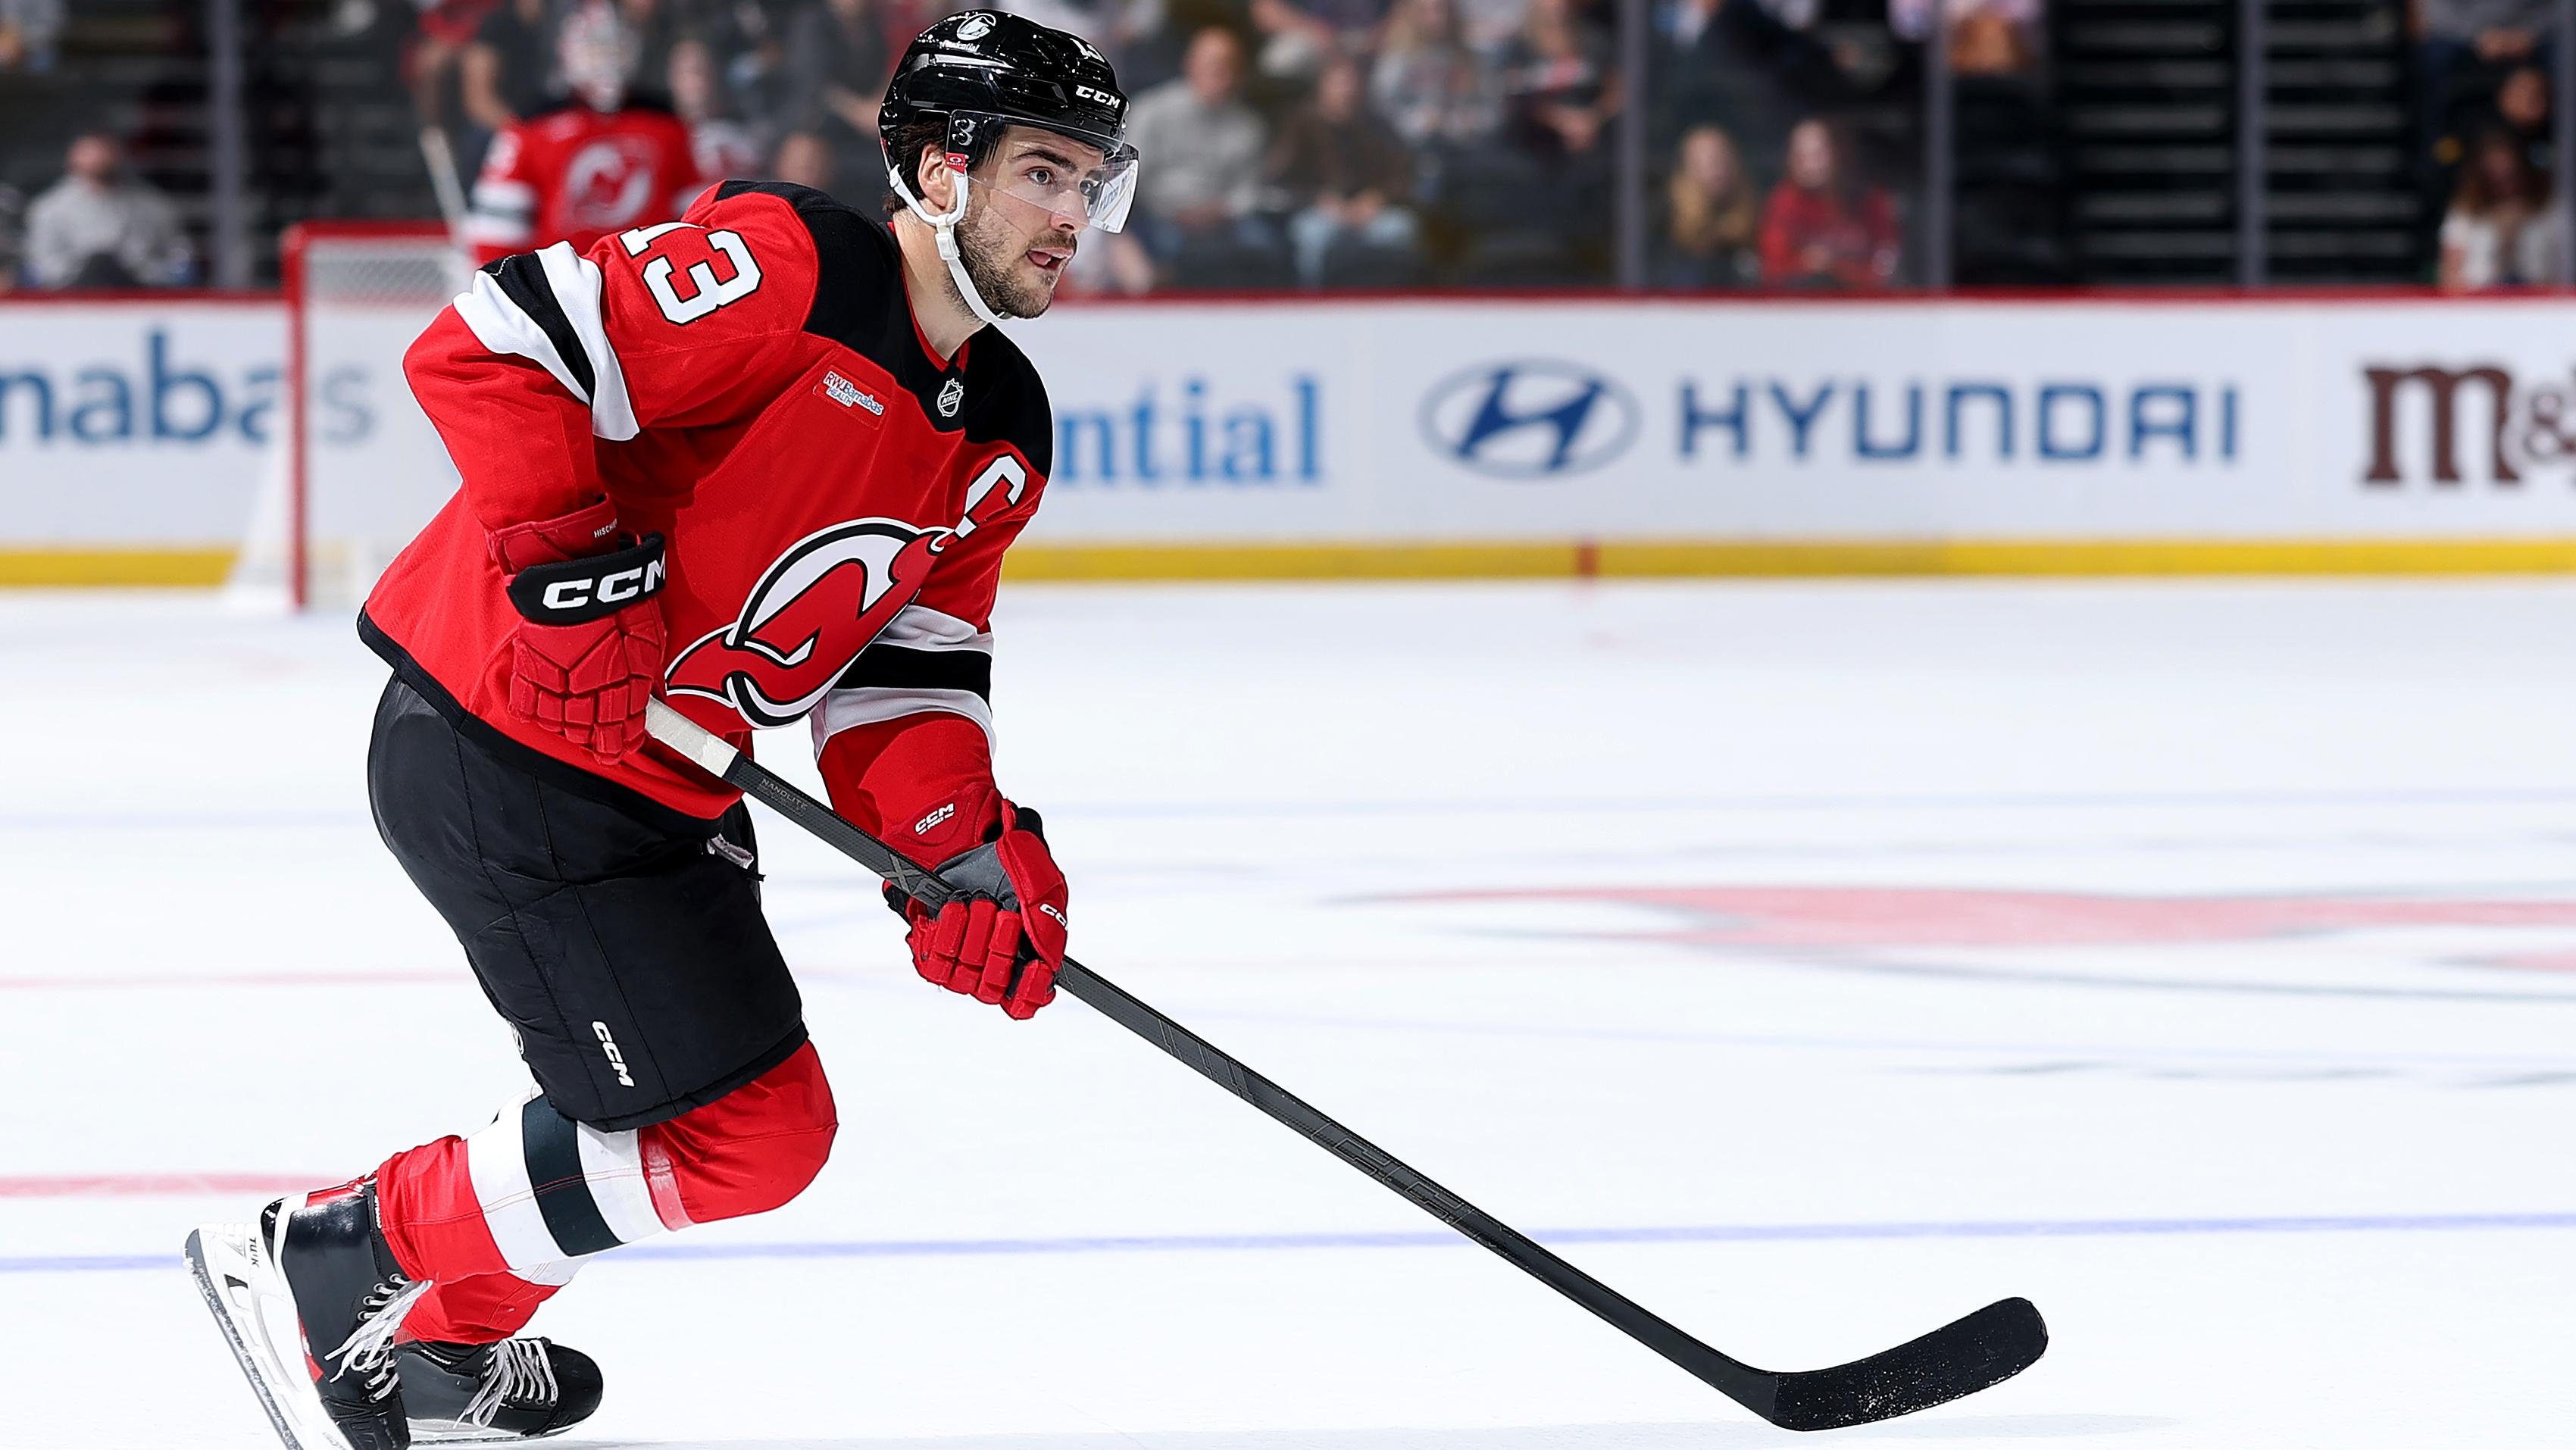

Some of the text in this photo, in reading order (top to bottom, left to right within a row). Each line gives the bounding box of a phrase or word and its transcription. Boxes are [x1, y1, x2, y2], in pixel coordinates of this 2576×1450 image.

[1075, 85, 1121, 108] CCM
[1055, 373, 1321, 485] ntial
[1678, 377, 2239, 464] HYUNDAI
[542, 549, 665, 609] CCM
[915, 803, 954, 833] CCM
[1039, 903, 1068, 931] CC
[592, 1021, 635, 1087] CCM
